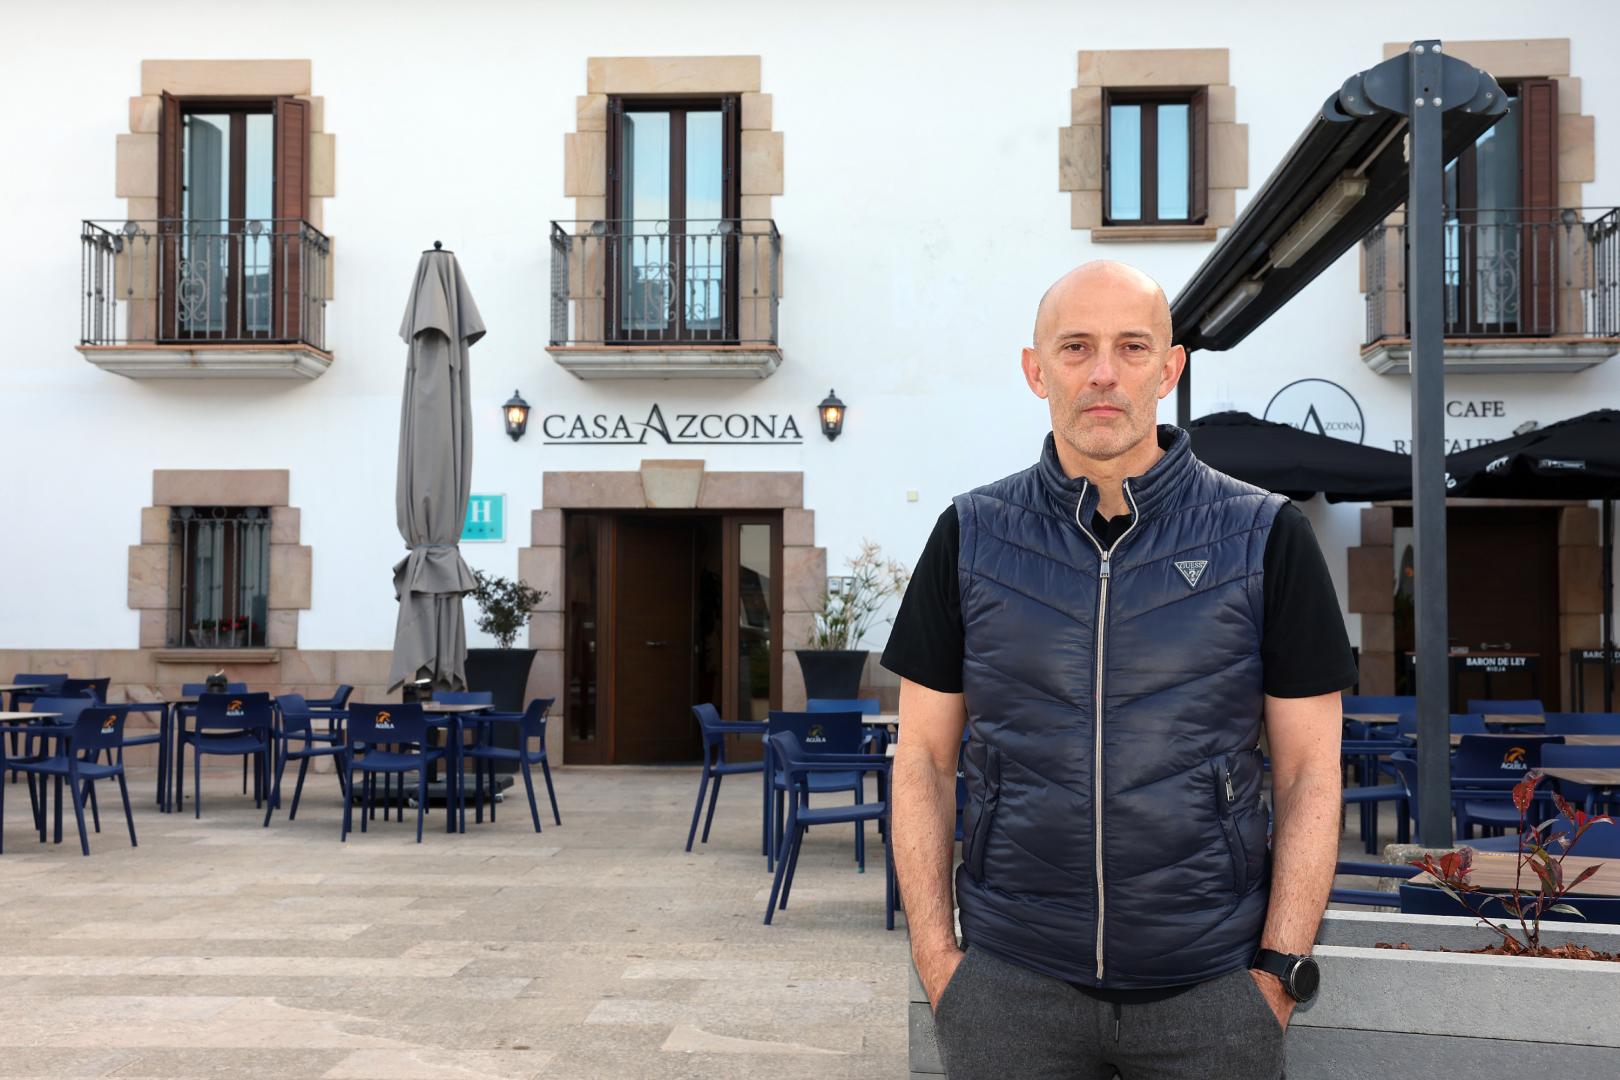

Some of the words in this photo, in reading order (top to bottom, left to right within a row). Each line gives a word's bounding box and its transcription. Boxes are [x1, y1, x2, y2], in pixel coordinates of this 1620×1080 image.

[1446, 400, 1505, 417] CAFE
[543, 414, 633, 438] CASA
[632, 403, 803, 444] AZCONA
[470, 500, 492, 522] H
[1497, 657, 1509, 666] DE
[1510, 657, 1526, 666] LEY
